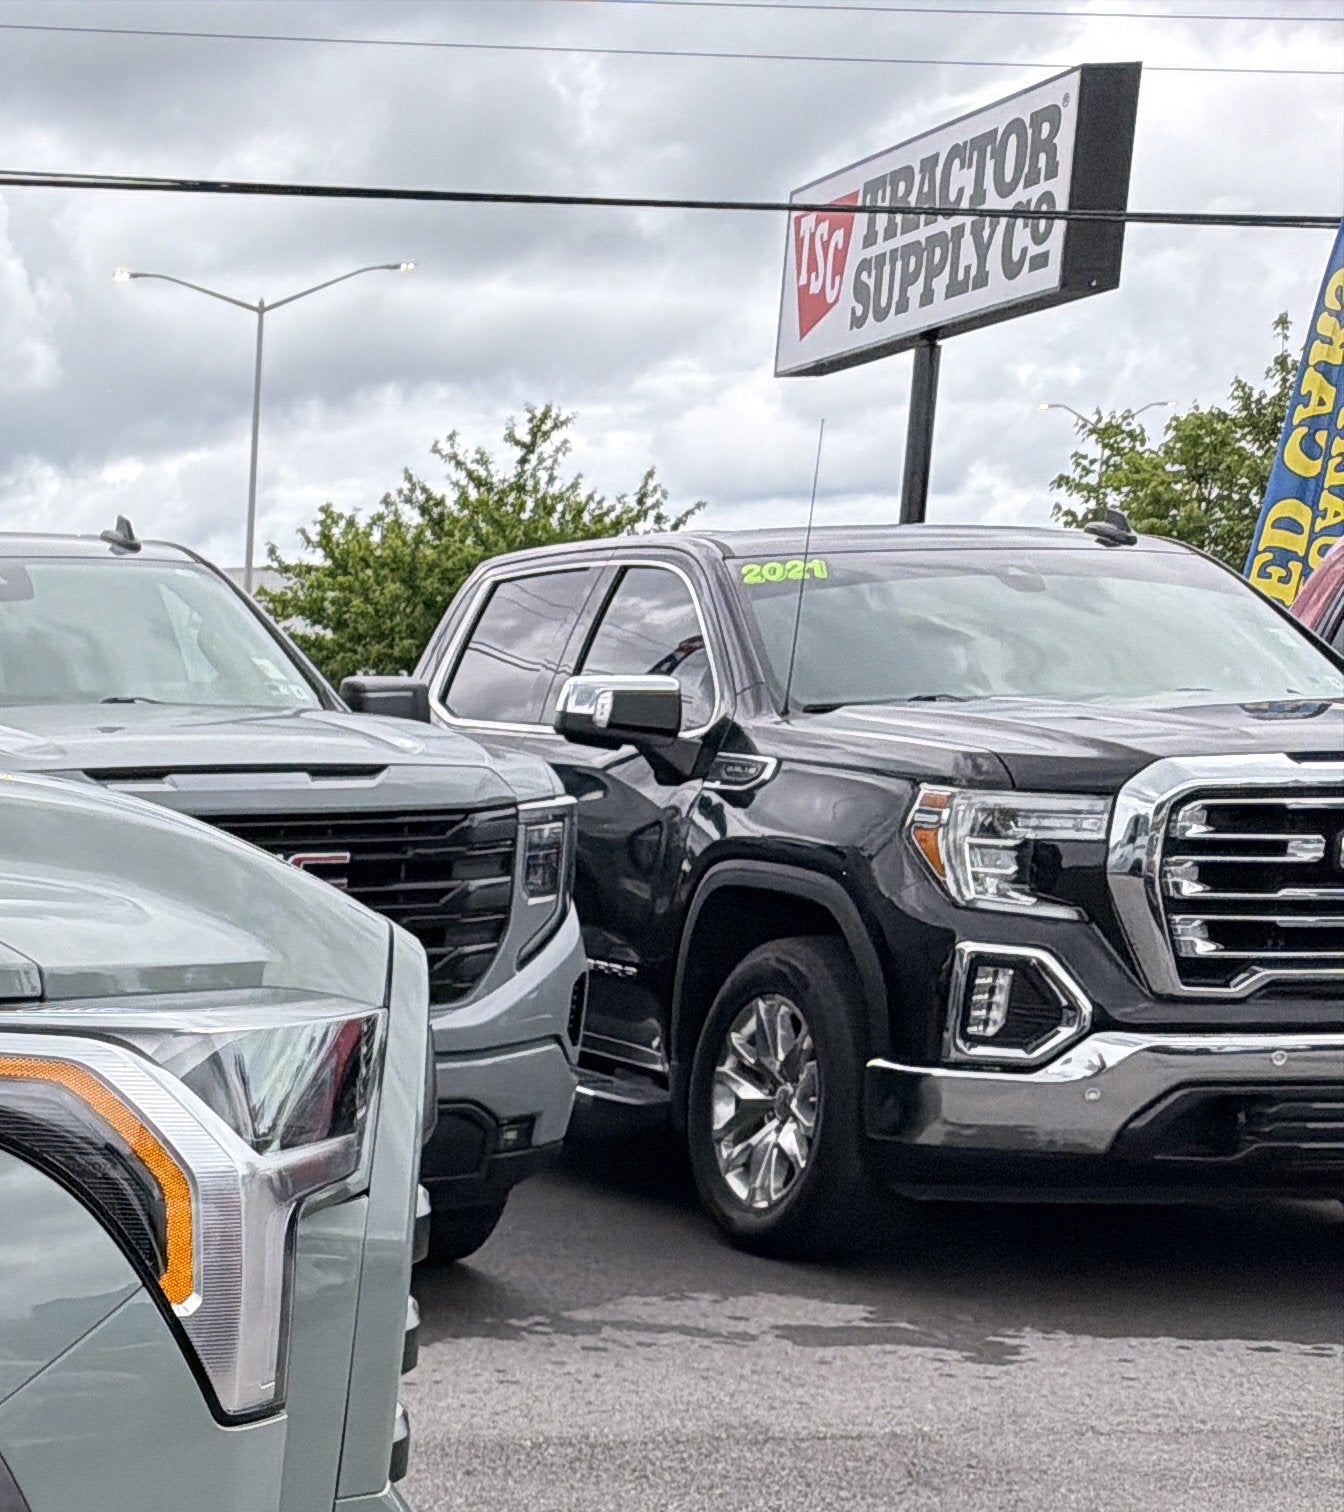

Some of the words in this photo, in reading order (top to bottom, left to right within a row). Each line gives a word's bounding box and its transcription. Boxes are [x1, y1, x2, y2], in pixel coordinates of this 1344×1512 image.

[861, 103, 1062, 250] TRACTOR
[798, 212, 845, 305] TSC
[849, 208, 1003, 332] SUPPLY
[740, 558, 828, 585] 2021
